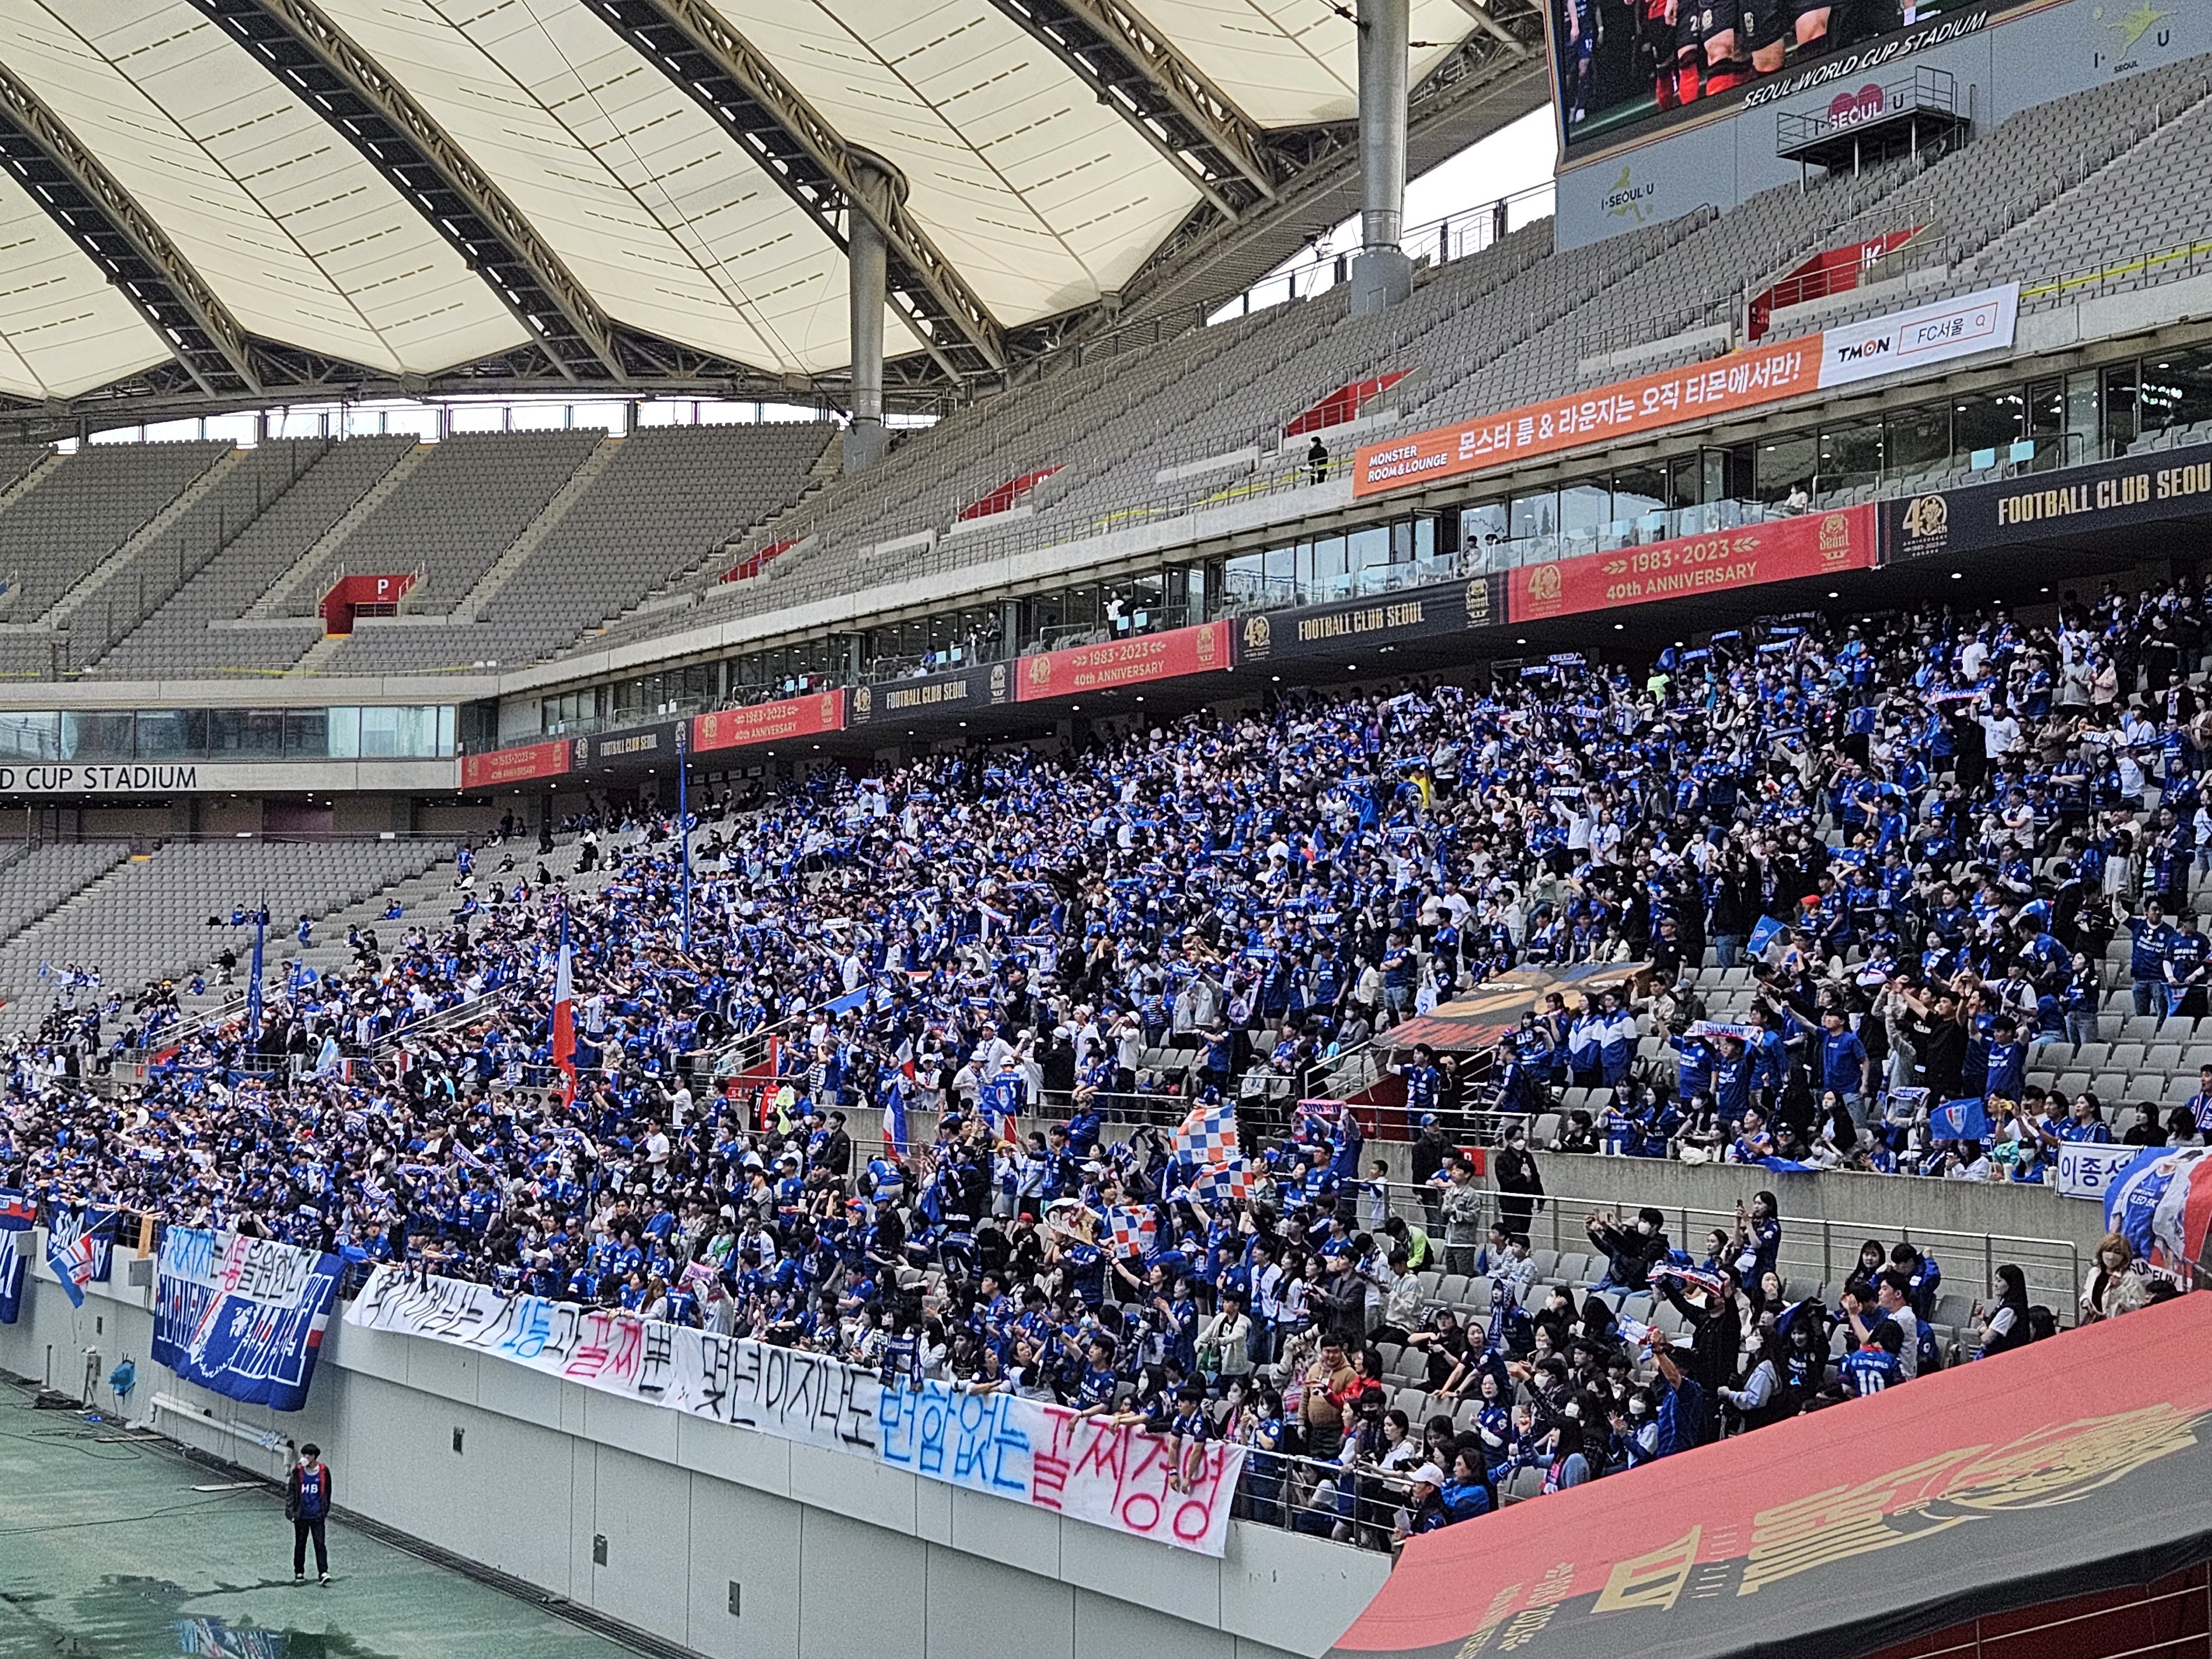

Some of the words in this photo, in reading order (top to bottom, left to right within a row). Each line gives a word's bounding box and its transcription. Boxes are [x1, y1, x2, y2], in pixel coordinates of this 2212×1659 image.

[1741, 77, 1791, 109] SEOUL
[1797, 55, 1858, 90] WORLD
[1861, 41, 1900, 69] CUP
[1903, 10, 1988, 53] STADIUM
[1838, 336, 1891, 363] TMON
[1917, 317, 1964, 344] FC서울
[1458, 421, 1511, 460] 몬스터
[1516, 416, 1535, 447] 룸
[1538, 413, 1554, 440] &
[1558, 394, 1636, 434] 라운지는
[1639, 381, 1680, 415] 오직
[1684, 351, 1802, 404] 티몬에서만!
[1369, 445, 1418, 468] MONSTER
[1998, 484, 2093, 526] FOOTBALL
[2096, 474, 2150, 510] CLUB
[378, 579, 389, 595] P
[1606, 581, 1641, 600] 40th
[1646, 561, 1758, 594] ANNIVERSARY
[1298, 613, 1353, 641] FOOTBALL
[1354, 609, 1384, 633] CLUB
[1387, 601, 1425, 628] SEOUL
[1073, 673, 1096, 686] 40th
[1097, 660, 1165, 683] ANNIVERSARY
[886, 688, 922, 709] FOOTBALL
[922, 684, 942, 704] CLUB
[943, 680, 968, 701] SEOUL
[751, 721, 797, 738] ANNIVERSARY
[26, 768, 73, 790] CUP
[84, 767, 197, 790] STADIUM
[301, 1483, 319, 1494] HB
